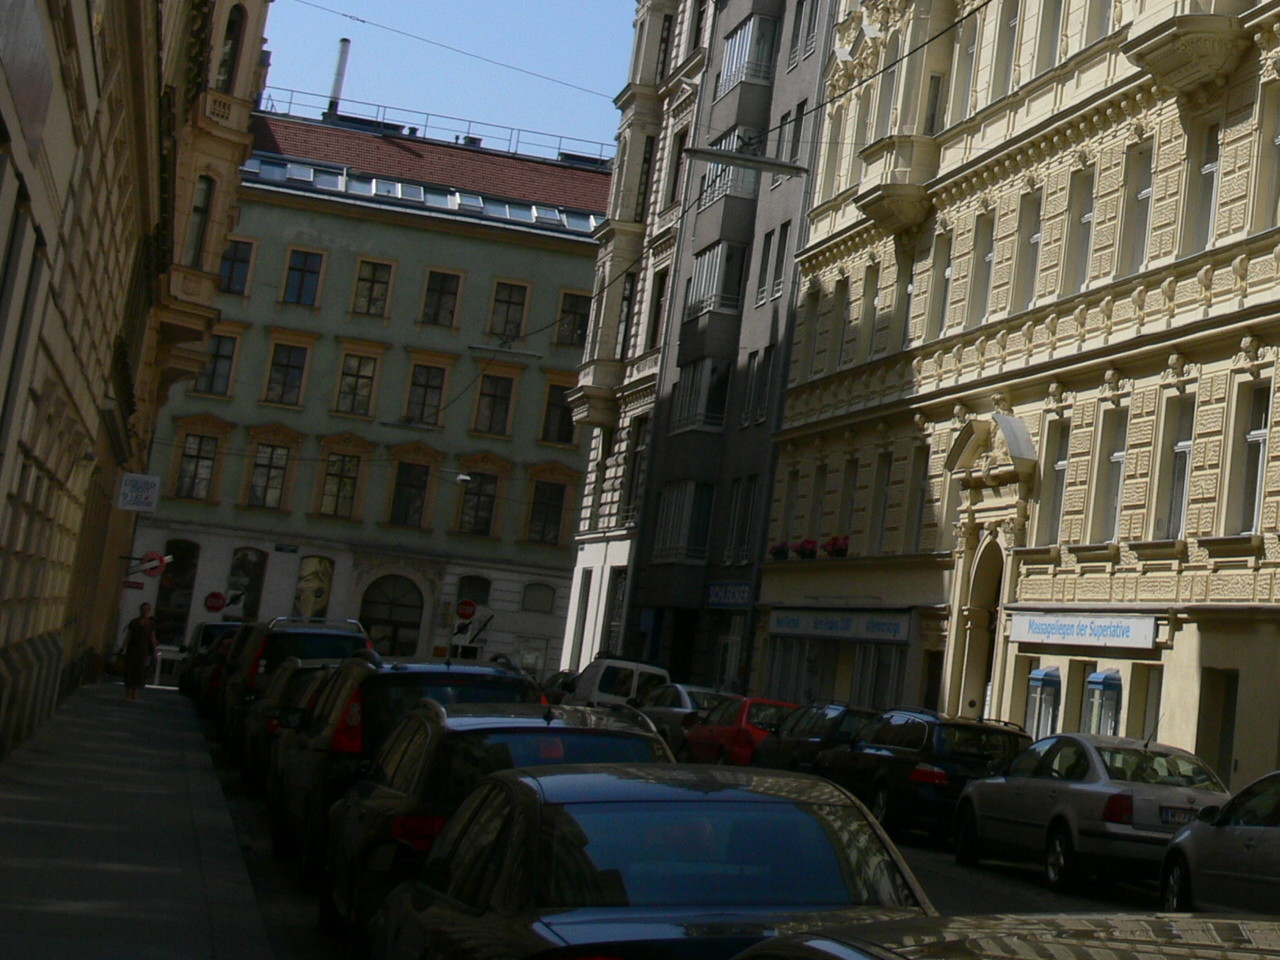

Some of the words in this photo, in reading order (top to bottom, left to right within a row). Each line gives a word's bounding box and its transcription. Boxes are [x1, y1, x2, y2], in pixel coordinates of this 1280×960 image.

[1028, 619, 1075, 639] Massageliegen
[1076, 620, 1088, 636] der
[1089, 621, 1131, 641] Superlative
